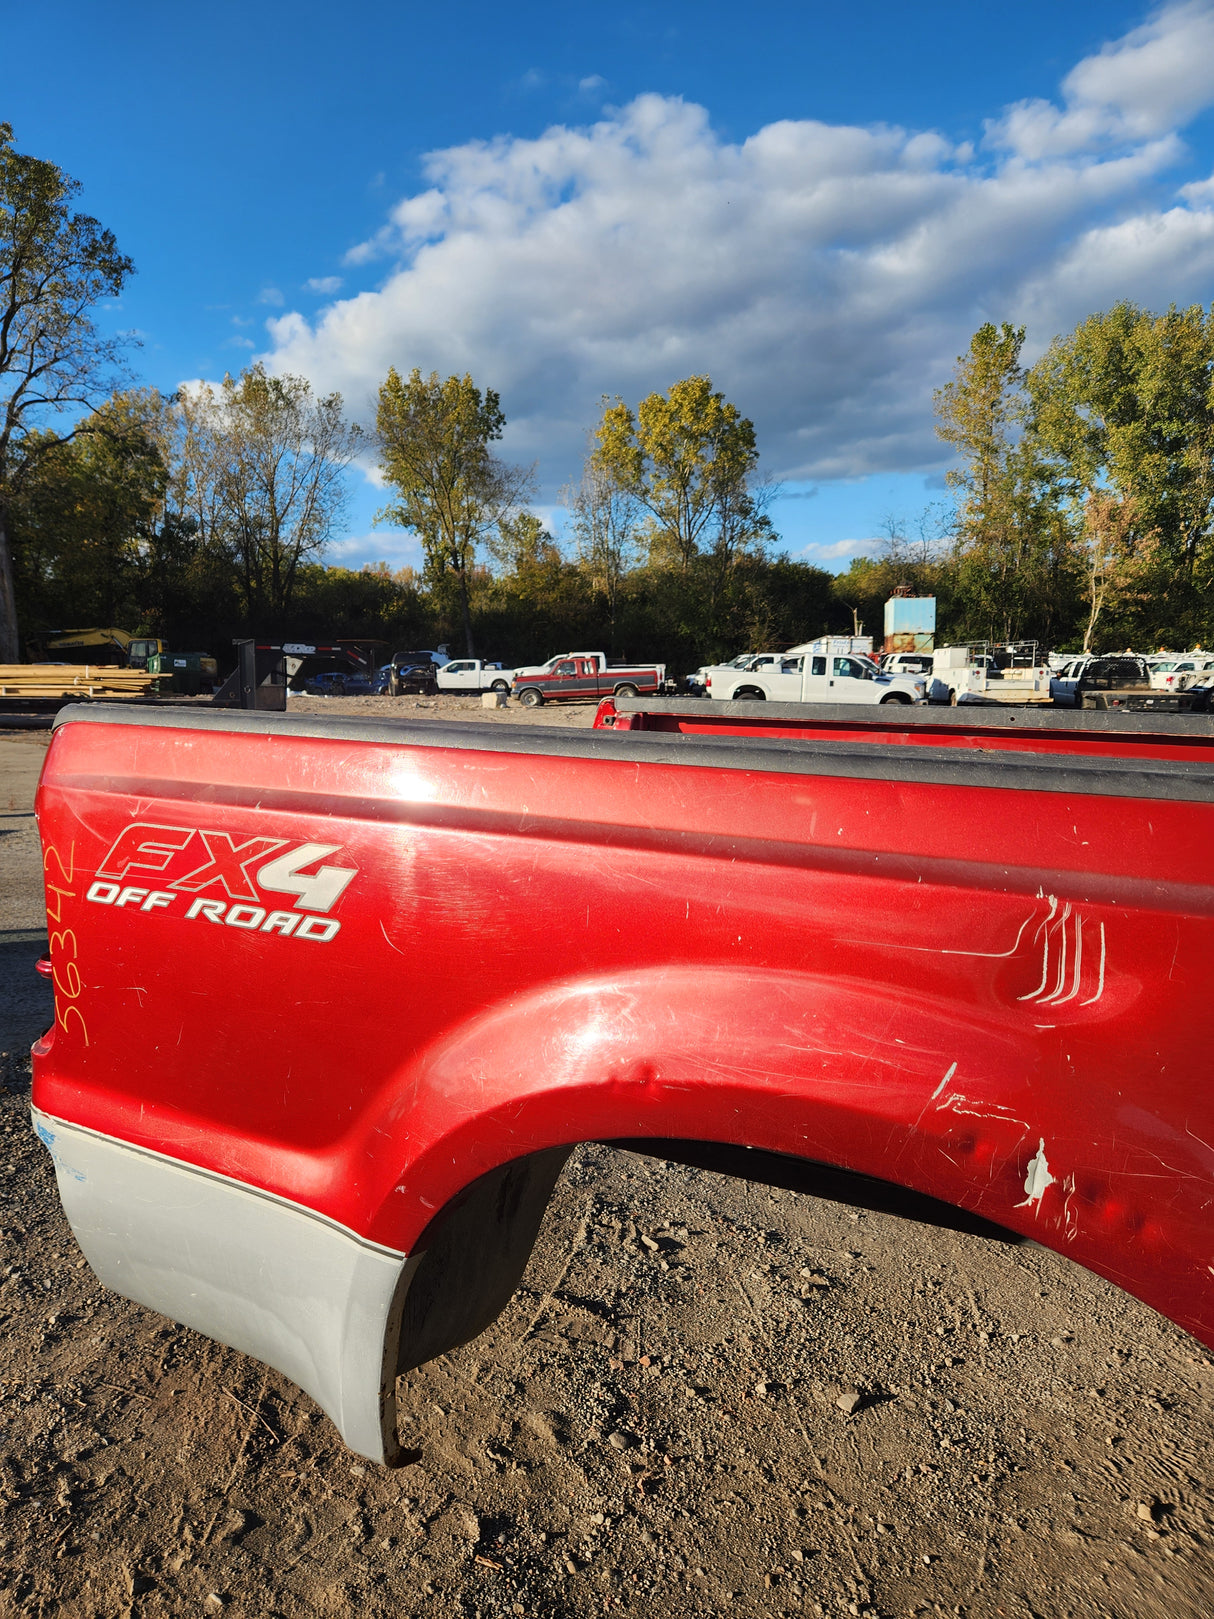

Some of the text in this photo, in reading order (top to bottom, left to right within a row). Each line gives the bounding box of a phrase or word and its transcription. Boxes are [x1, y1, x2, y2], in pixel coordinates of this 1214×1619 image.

[86, 880, 342, 943] OFF ROAD
[95, 822, 358, 913] FX4
[43, 839, 90, 1047] 56342
